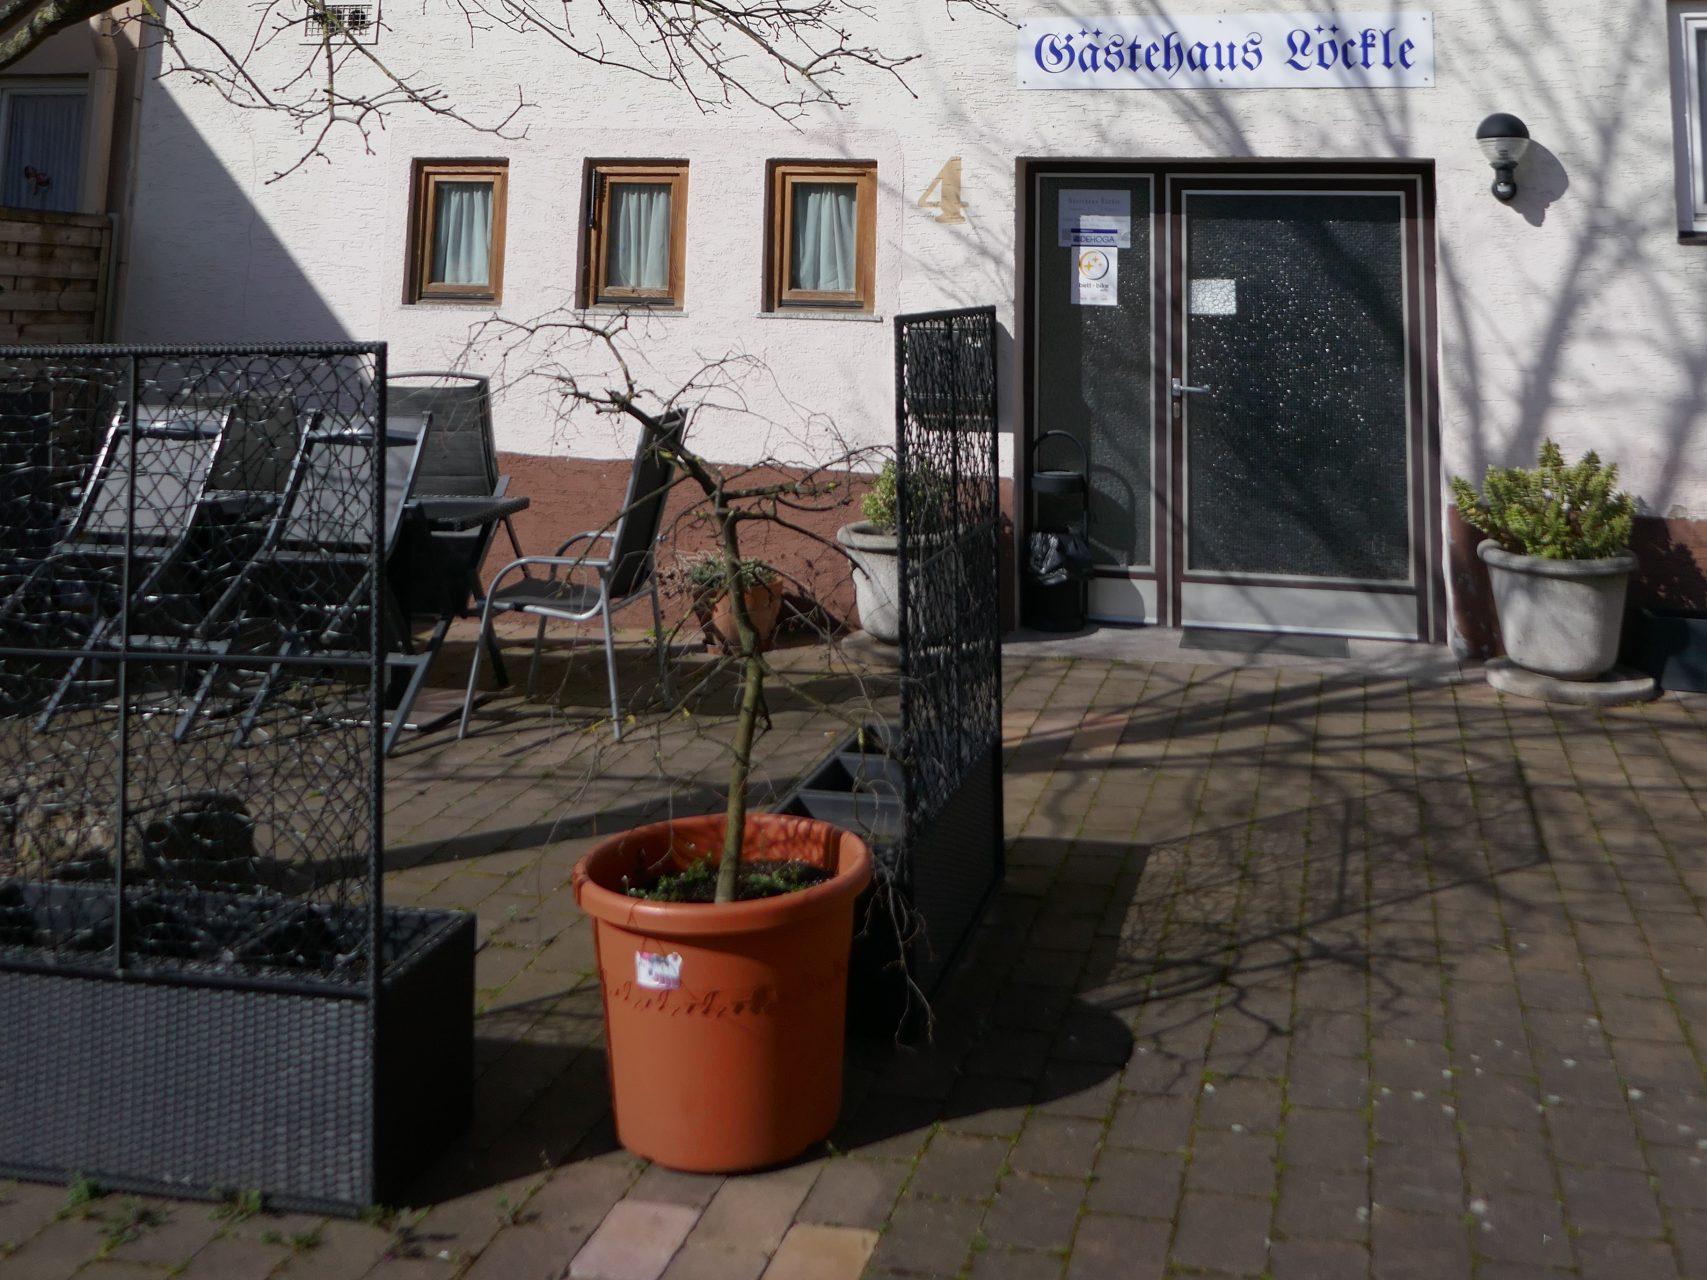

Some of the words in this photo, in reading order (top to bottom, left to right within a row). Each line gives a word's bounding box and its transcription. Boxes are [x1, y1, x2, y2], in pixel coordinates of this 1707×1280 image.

[1034, 27, 1263, 79] Gästehaus
[1284, 23, 1417, 71] Löckle
[918, 156, 970, 224] 4
[1080, 235, 1115, 243] DEHOGA
